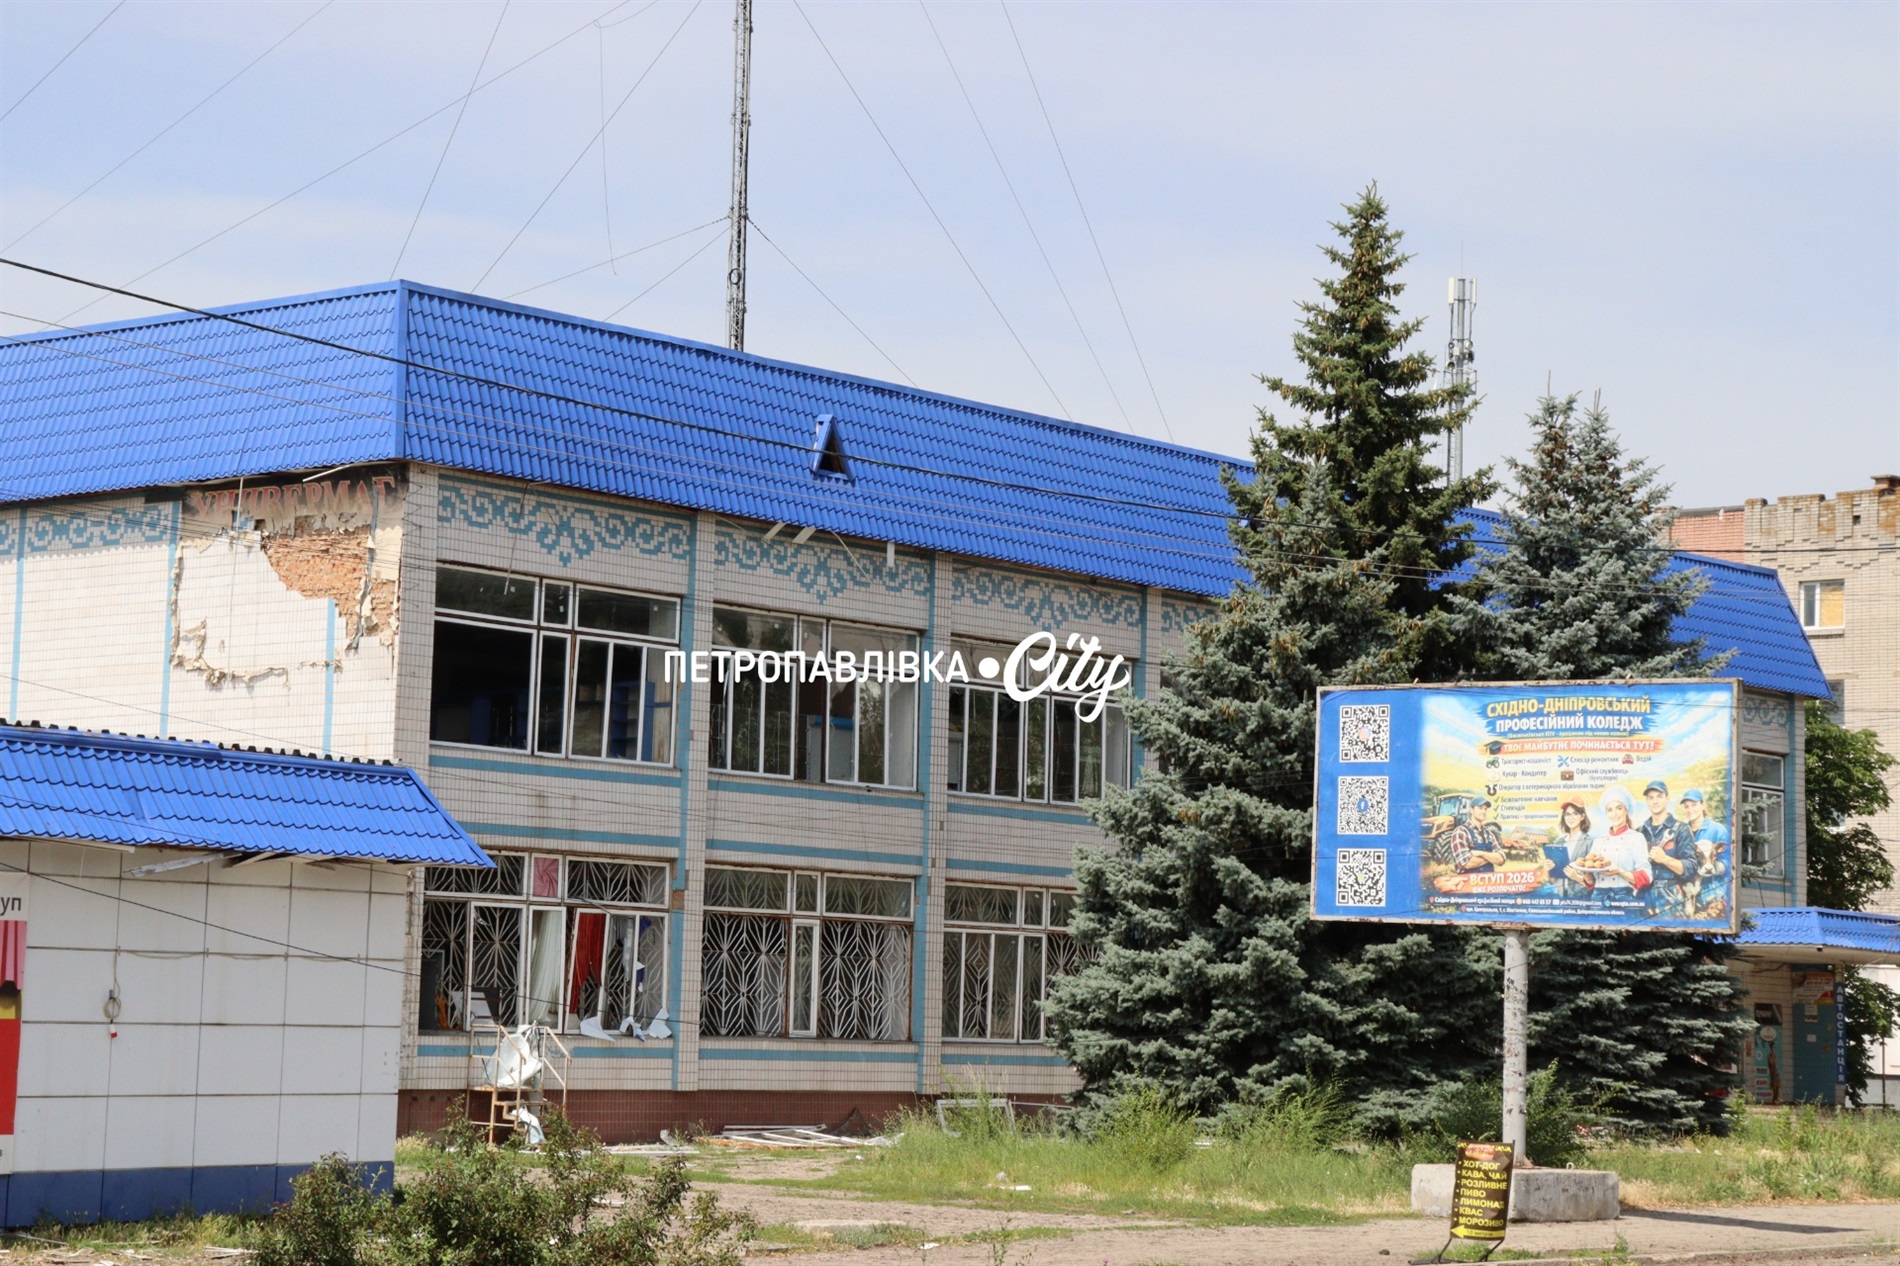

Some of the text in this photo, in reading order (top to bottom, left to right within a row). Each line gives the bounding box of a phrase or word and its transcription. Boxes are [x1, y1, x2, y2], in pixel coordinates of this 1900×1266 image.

[1486, 695, 1650, 717] СХІДНО-ДНІПРОВСЬКИЙ
[1496, 713, 1643, 732] ПРОФЕСІЙНИЙ КОЛЕДЖ
[1633, 740, 1654, 750] ТУТ!
[1470, 872, 1534, 885] ВСТУП 2026
[0, 897, 21, 916] уп
[1837, 986, 1845, 1082] АВТОСТАНЦІЯ
[1463, 1160, 1501, 1170] ХОТ-ДОГ
[1461, 1170, 1507, 1180] КАВА, ЧАЙ
[1461, 1179, 1507, 1190] РОЗЛИВНЕ
[1460, 1188, 1486, 1197] ПИВО
[1460, 1198, 1504, 1209] ЛИМОНАД
[1459, 1207, 1483, 1216] КВАС
[1459, 1216, 1503, 1227] МОРОЗИВО
